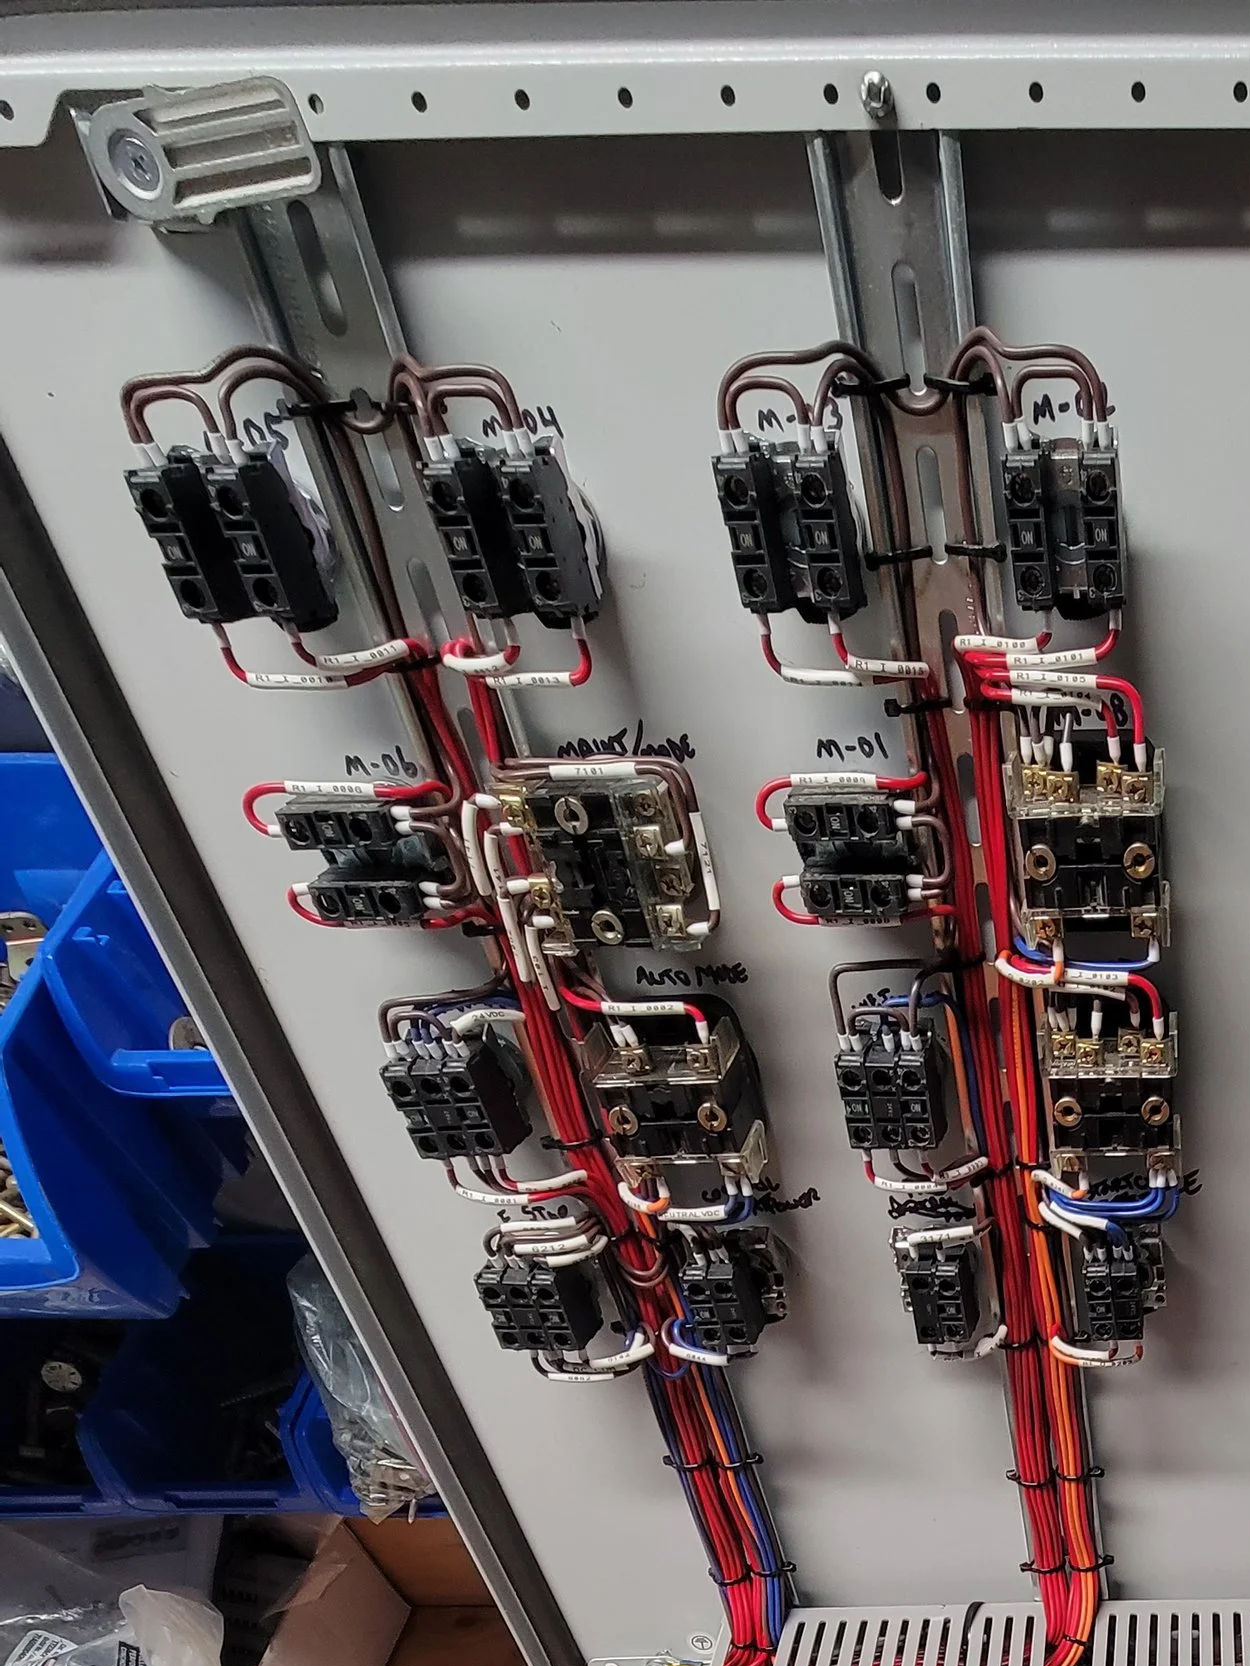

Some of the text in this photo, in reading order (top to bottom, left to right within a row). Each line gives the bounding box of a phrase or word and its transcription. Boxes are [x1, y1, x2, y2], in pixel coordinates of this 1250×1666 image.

[453, 535, 468, 551] ON
[529, 535, 544, 551] ON
[740, 533, 753, 547] ON
[815, 531, 829, 546] ON
[1021, 531, 1034, 545] ON
[1094, 529, 1108, 543] ON
[168, 544, 182, 560] ON
[242, 540, 256, 557] ON
